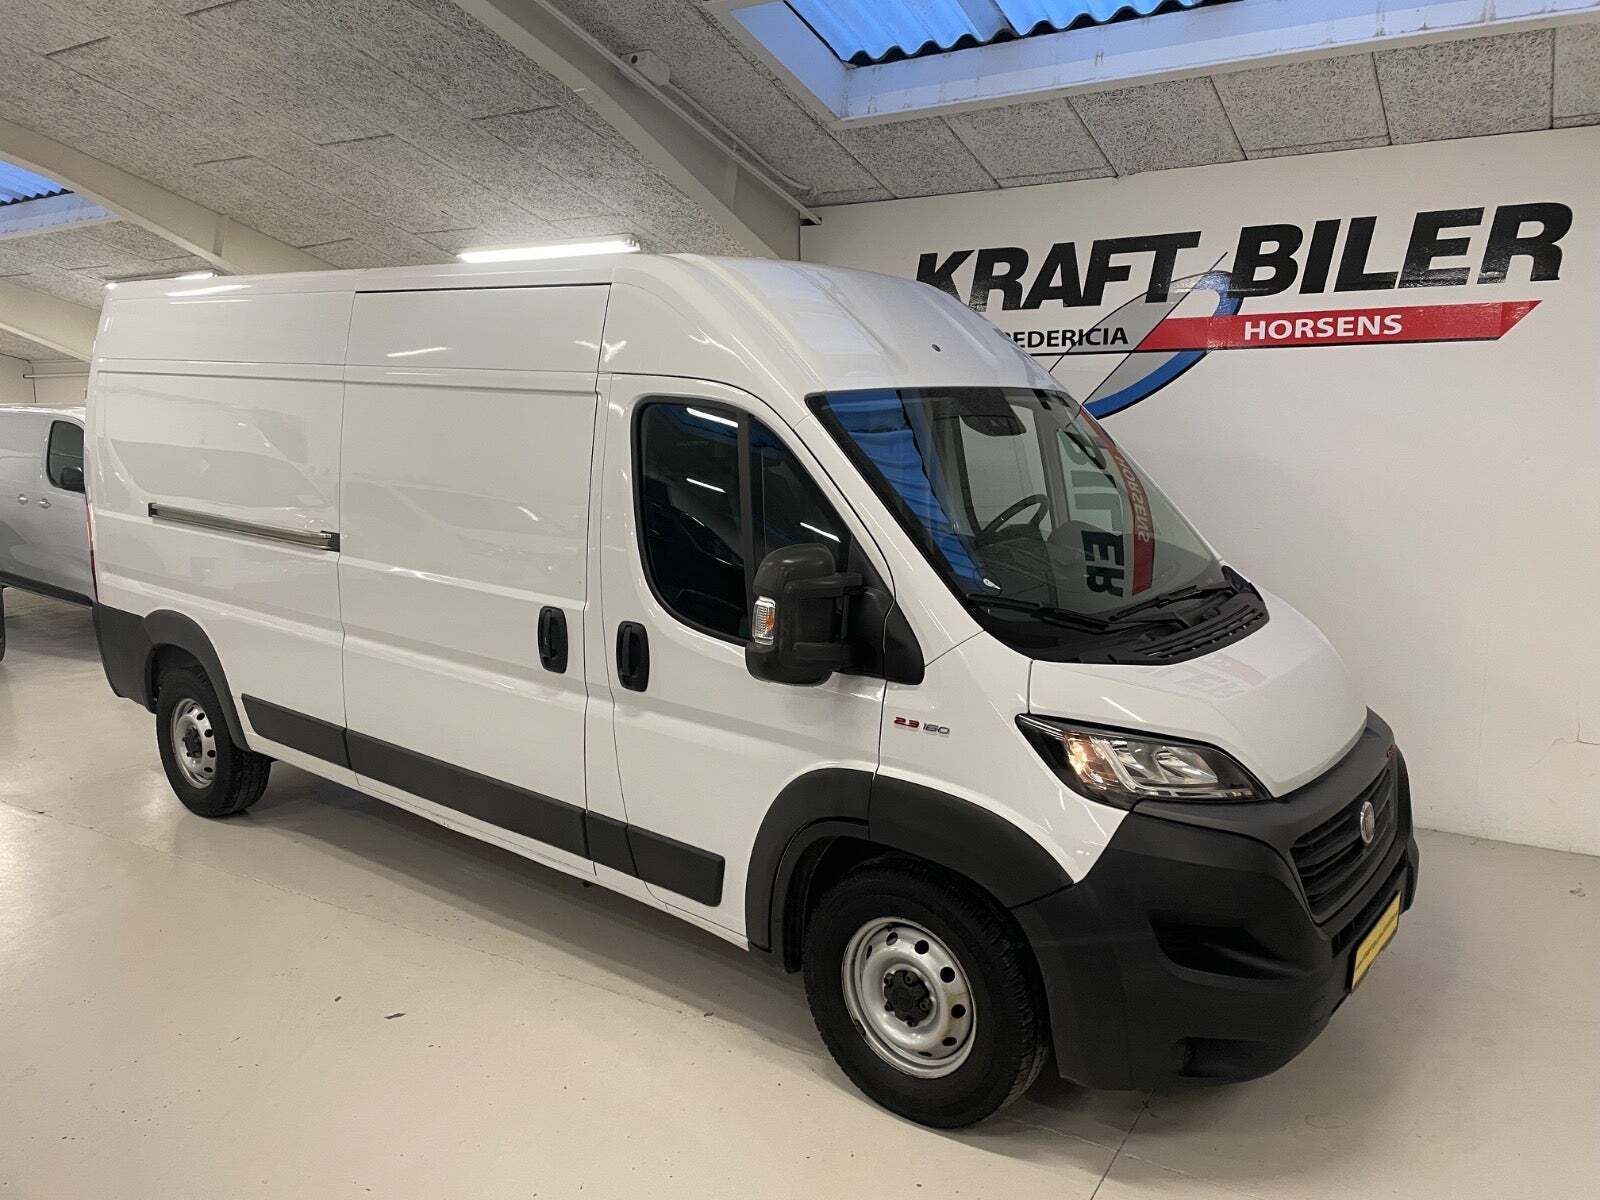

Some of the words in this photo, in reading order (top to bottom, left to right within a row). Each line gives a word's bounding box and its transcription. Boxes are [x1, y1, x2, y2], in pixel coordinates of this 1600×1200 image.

[916, 231, 1202, 312] KRAFT
[1227, 202, 1573, 298] BILER
[1004, 327, 1129, 348] EDERICIA
[1244, 314, 1402, 341] HORSENS
